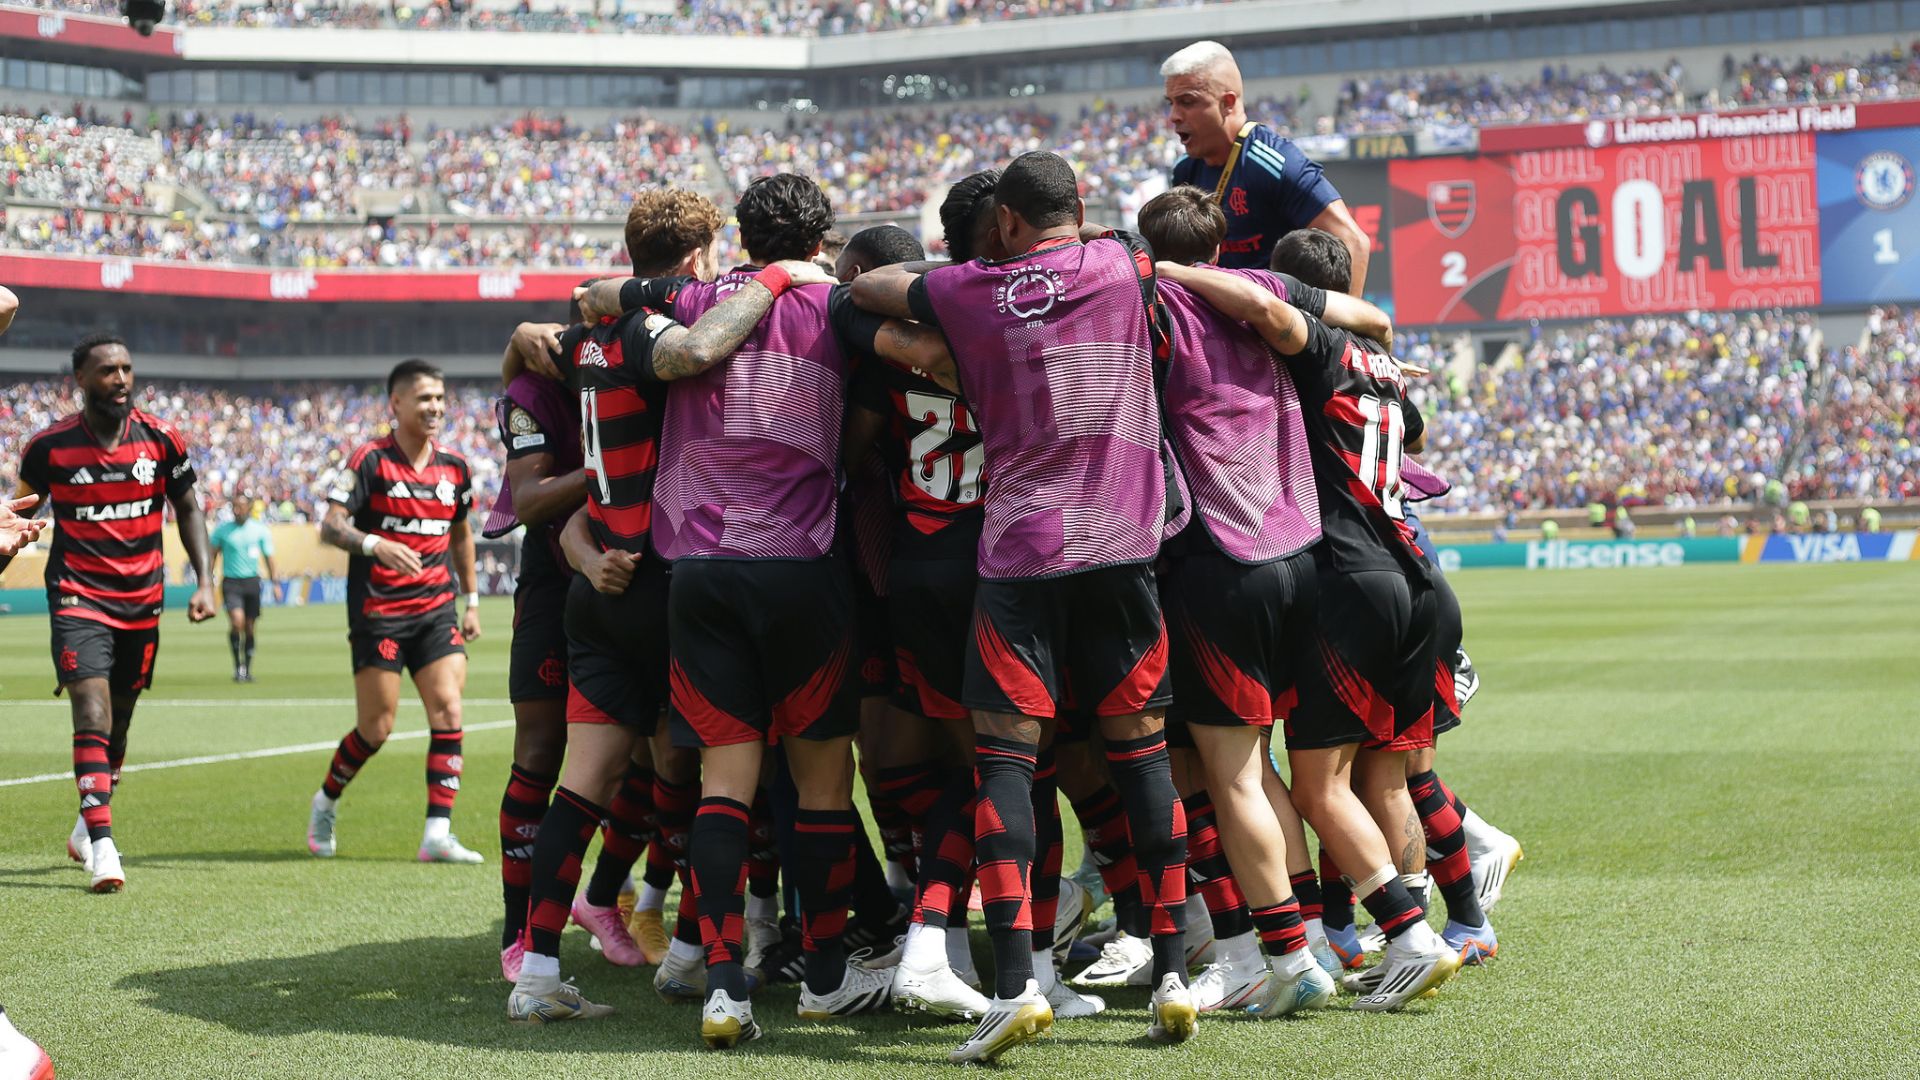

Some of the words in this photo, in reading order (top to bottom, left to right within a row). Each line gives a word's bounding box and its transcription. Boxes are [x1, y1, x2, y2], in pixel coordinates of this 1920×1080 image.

[1614, 112, 1696, 143] Lincoln
[1698, 105, 1799, 138] Financial
[1801, 98, 1856, 131] Field
[1356, 136, 1410, 159] FIFA
[1556, 176, 1779, 278] GOAL
[1873, 227, 1900, 264] 1
[1004, 264, 1042, 283] WORLD
[1440, 251, 1468, 287] 2
[1026, 320, 1045, 329] FIFA
[75, 498, 153, 521] FLABET
[1525, 540, 1685, 569] Hisense
[1788, 533, 1862, 562] VISA
